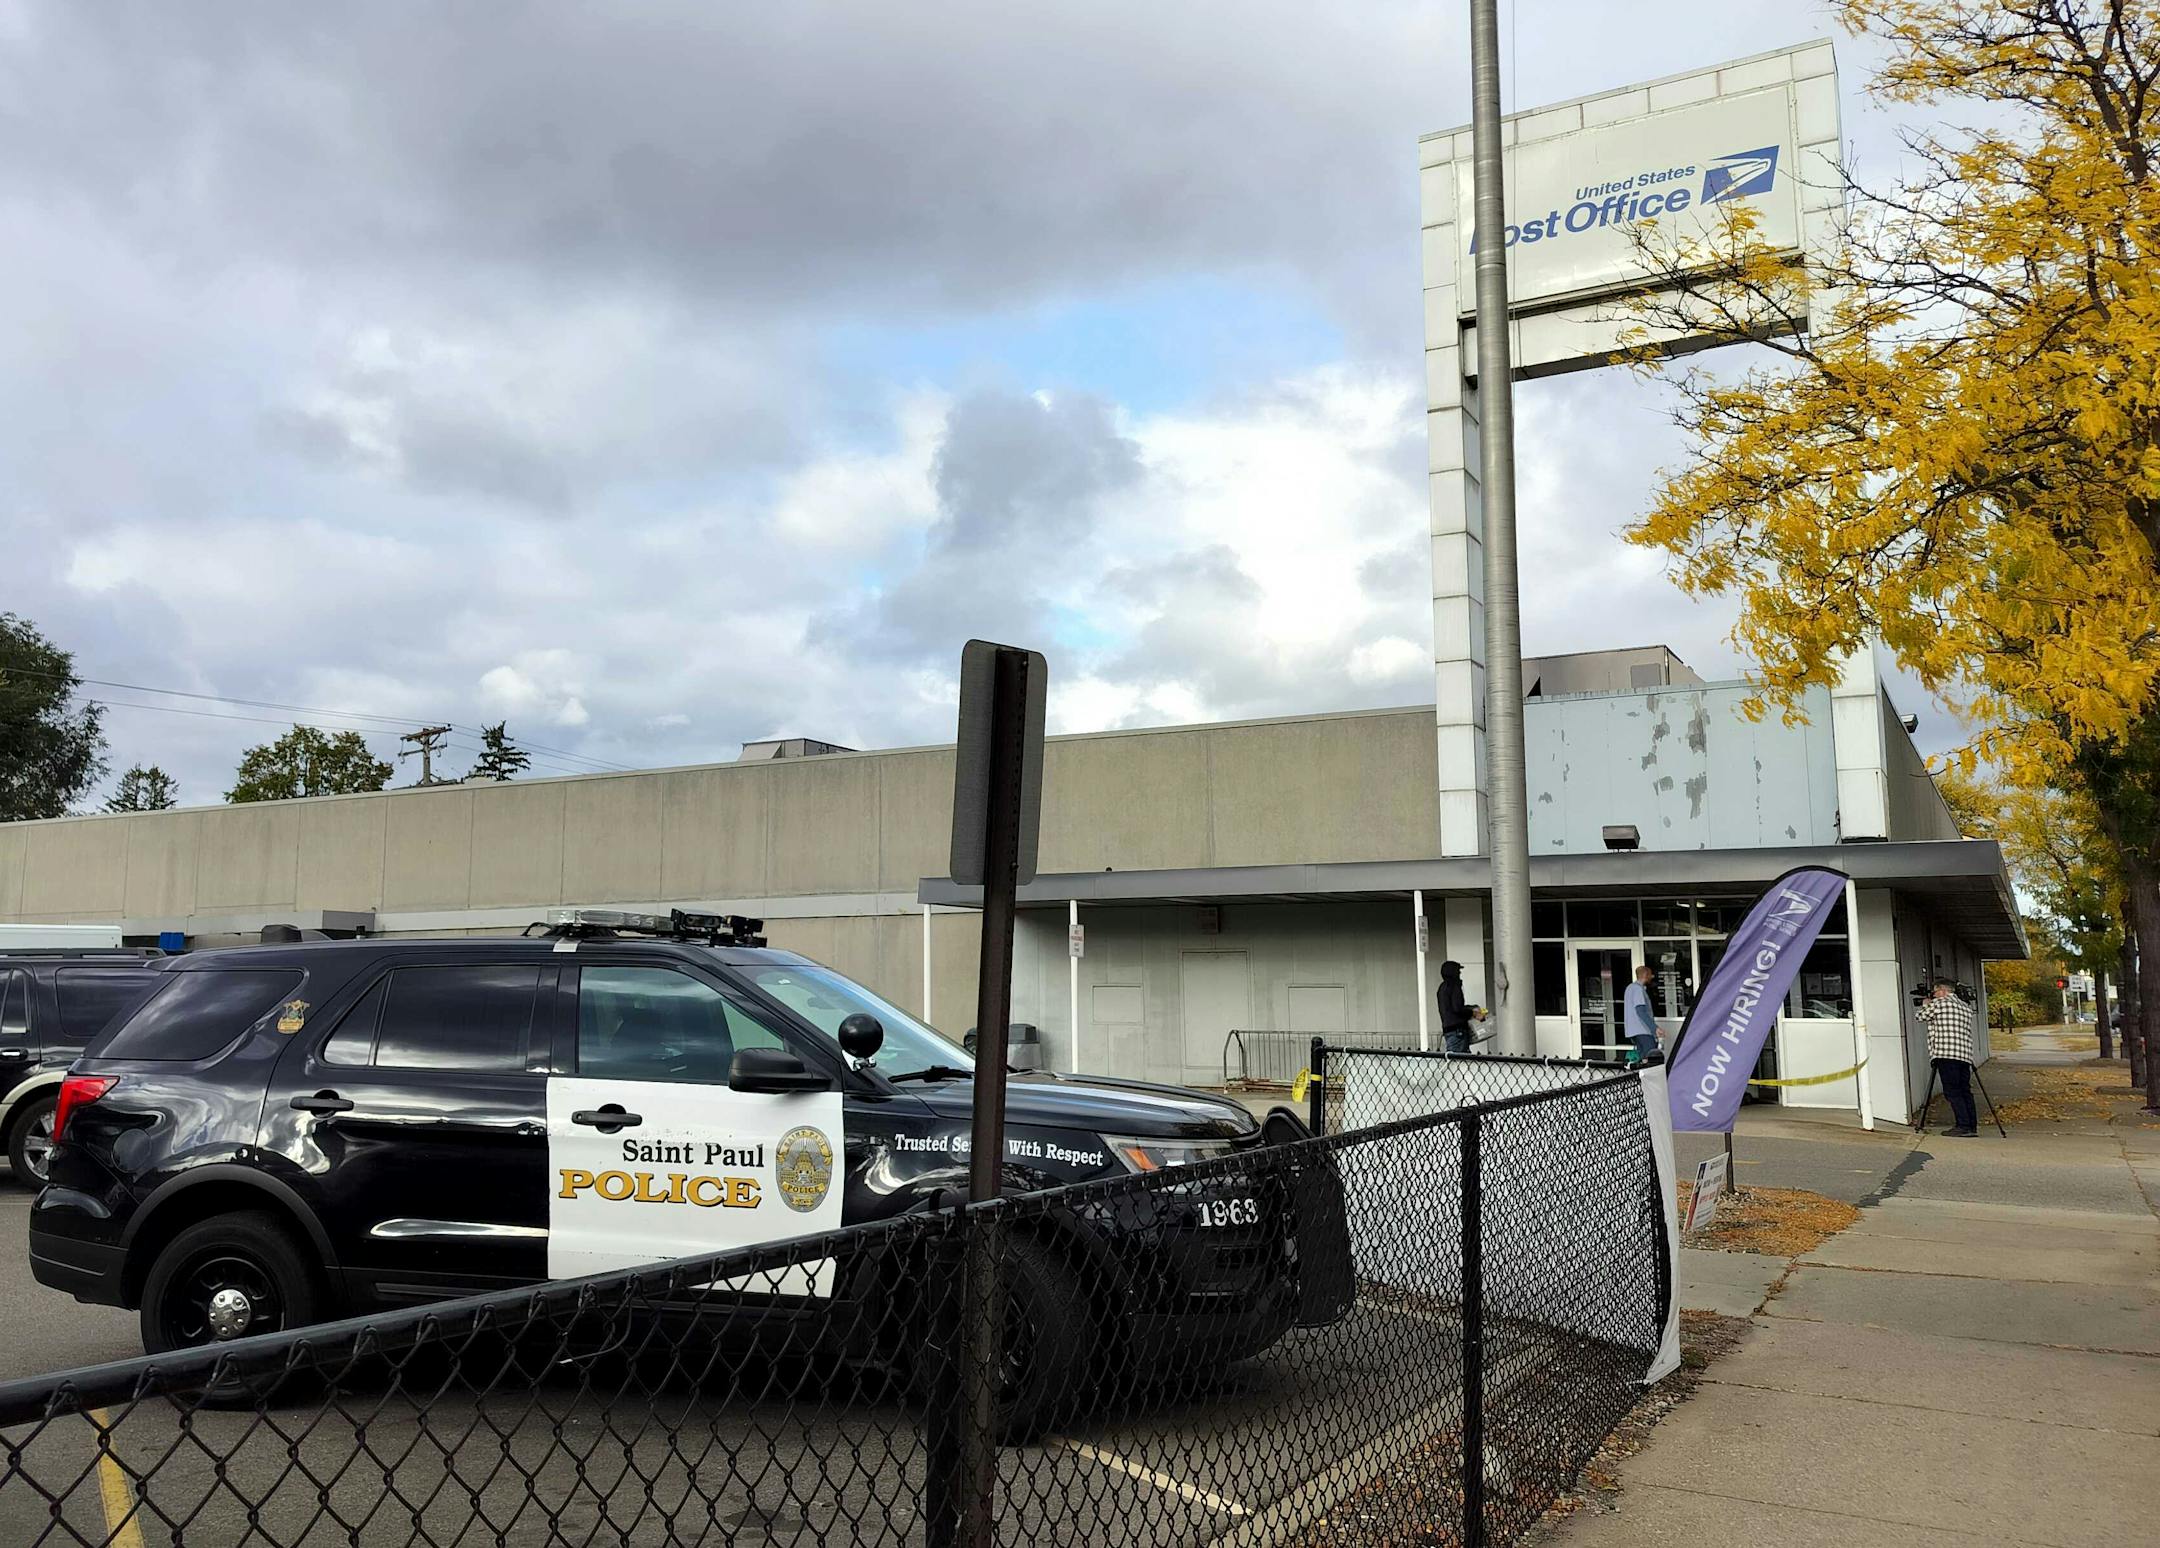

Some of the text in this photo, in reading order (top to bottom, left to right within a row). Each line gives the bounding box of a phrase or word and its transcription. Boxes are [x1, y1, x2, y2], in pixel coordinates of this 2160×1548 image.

[1575, 165, 1696, 201] United States
[1469, 188, 1691, 255] ost Office
[1692, 1045, 1732, 1117] NOW
[1722, 940, 1781, 1044] HIRING!
[623, 1139, 765, 1167] Saint Paul
[895, 1134, 948, 1152] Trusted
[1008, 1140, 1042, 1158] With
[1046, 1144, 1104, 1166] Respect
[558, 1169, 762, 1208] POLICE
[787, 1185, 820, 1194] POLICE
[1198, 1198, 1259, 1227] 1963
